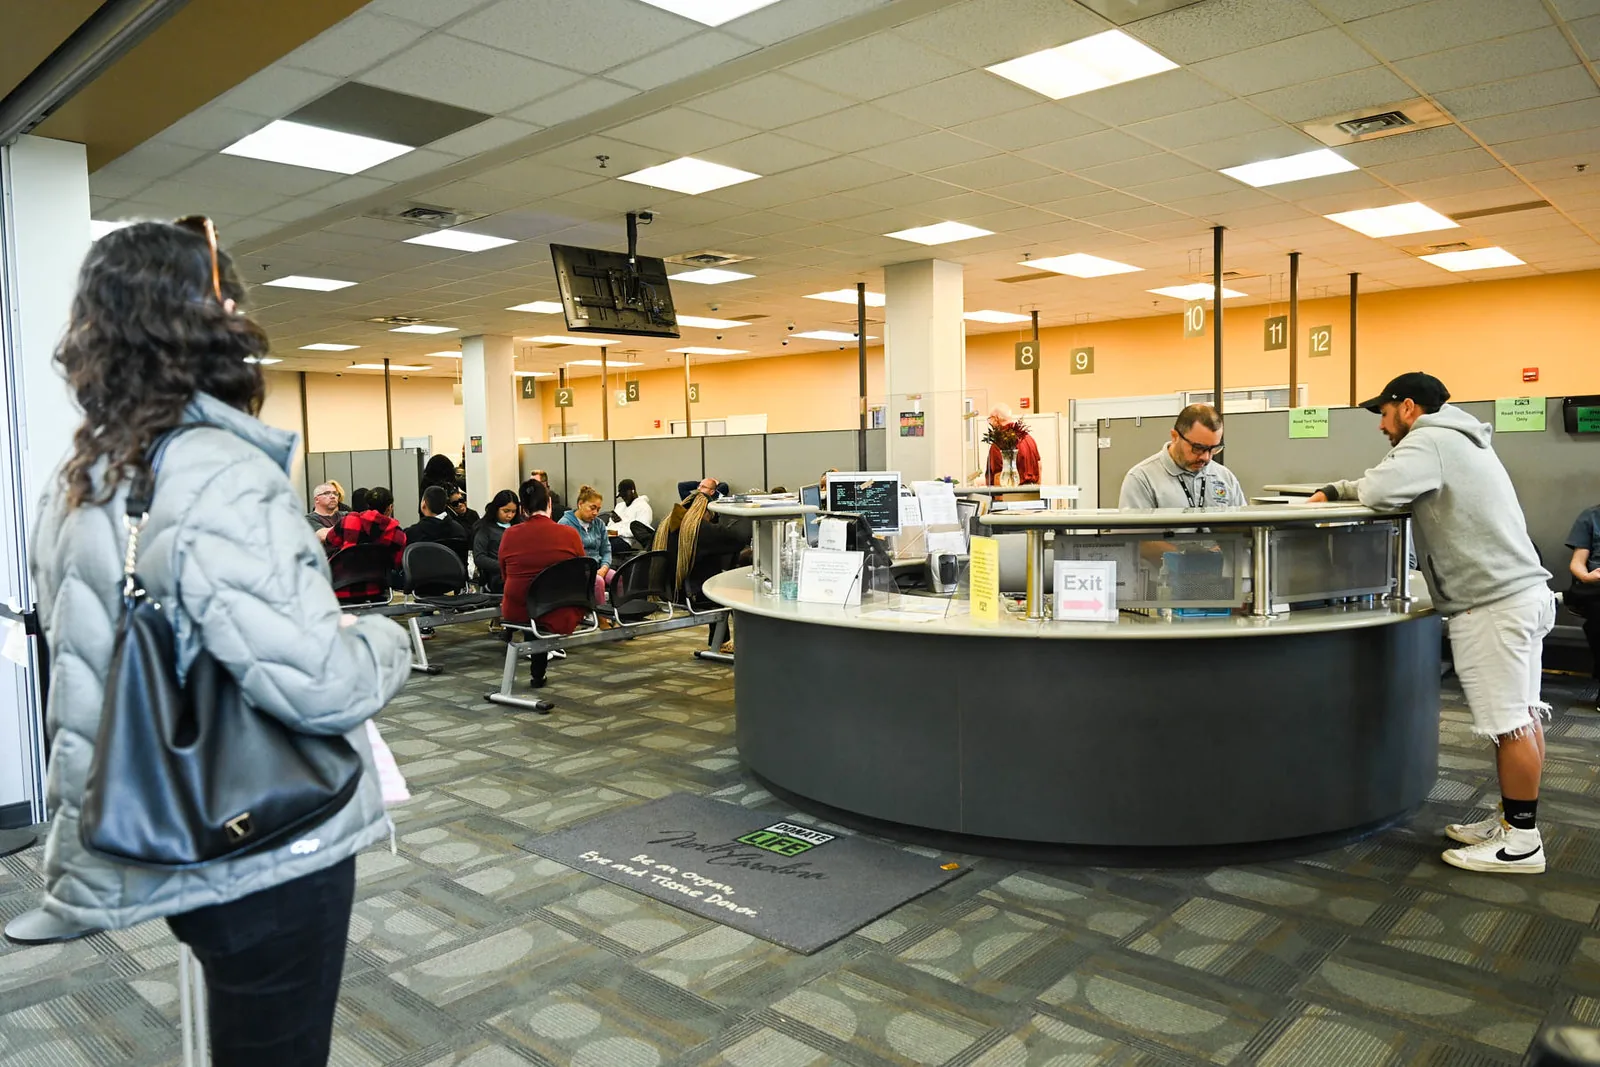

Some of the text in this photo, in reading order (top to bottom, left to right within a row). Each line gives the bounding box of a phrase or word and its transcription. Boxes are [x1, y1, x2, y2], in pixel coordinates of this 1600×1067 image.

[1186, 305, 1204, 332] 10
[1268, 323, 1283, 345] 11
[1311, 331, 1329, 352] 12
[1020, 346, 1034, 365] 8
[1075, 352, 1088, 370] 9
[525, 380, 532, 395] 4
[629, 385, 636, 398] 5
[689, 387, 696, 400] 6
[559, 391, 568, 404] 2
[618, 392, 627, 406] 3
[1064, 575, 1103, 591] Exit
[775, 823, 829, 842] DONATE
[648, 830, 740, 856] North
[744, 832, 805, 854] LIFE
[578, 850, 613, 866] Eye
[611, 863, 649, 878] and
[651, 873, 704, 898] Tissue
[630, 854, 656, 866] Be
[655, 864, 679, 875] an
